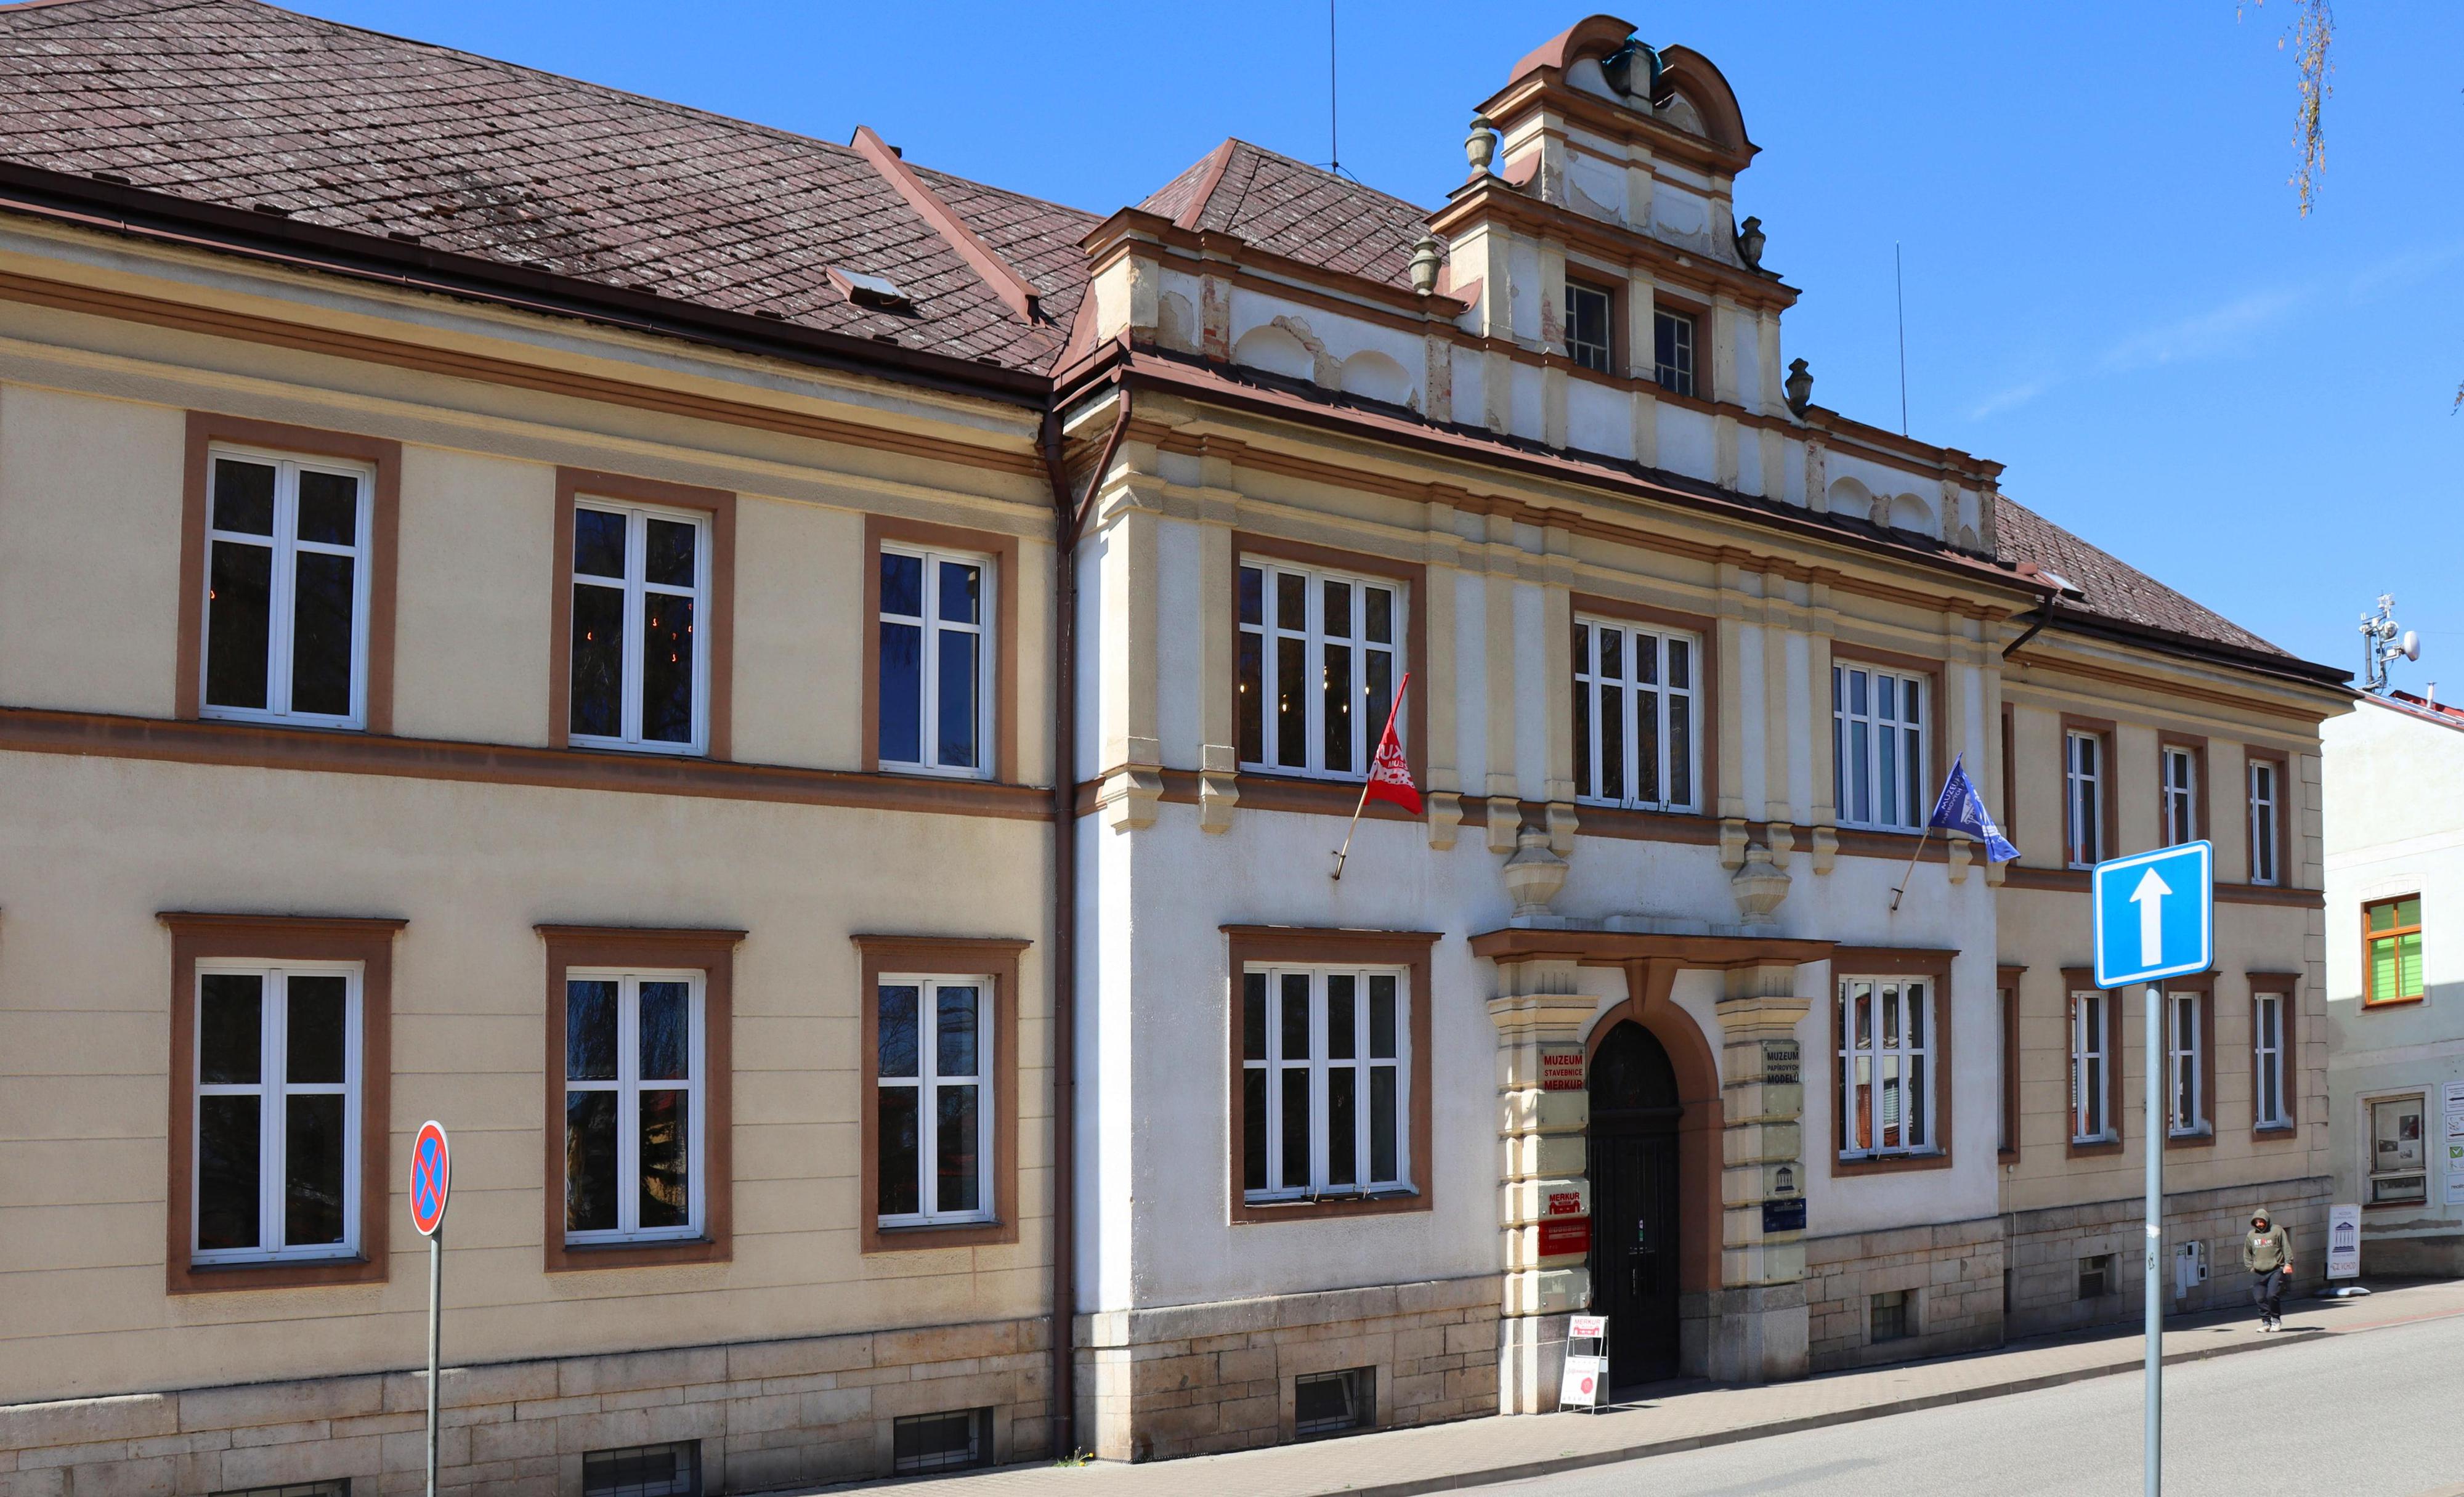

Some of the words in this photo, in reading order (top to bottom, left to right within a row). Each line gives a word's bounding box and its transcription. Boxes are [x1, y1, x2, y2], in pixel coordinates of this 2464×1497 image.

[1544, 1055, 1583, 1065] MUZEUM
[1767, 1052, 1799, 1060] MUZEUM
[1767, 1071, 1799, 1084] MODELŮ
[1544, 1080, 1583, 1090] MERKUR
[1549, 1192, 1580, 1201] MERKUR
